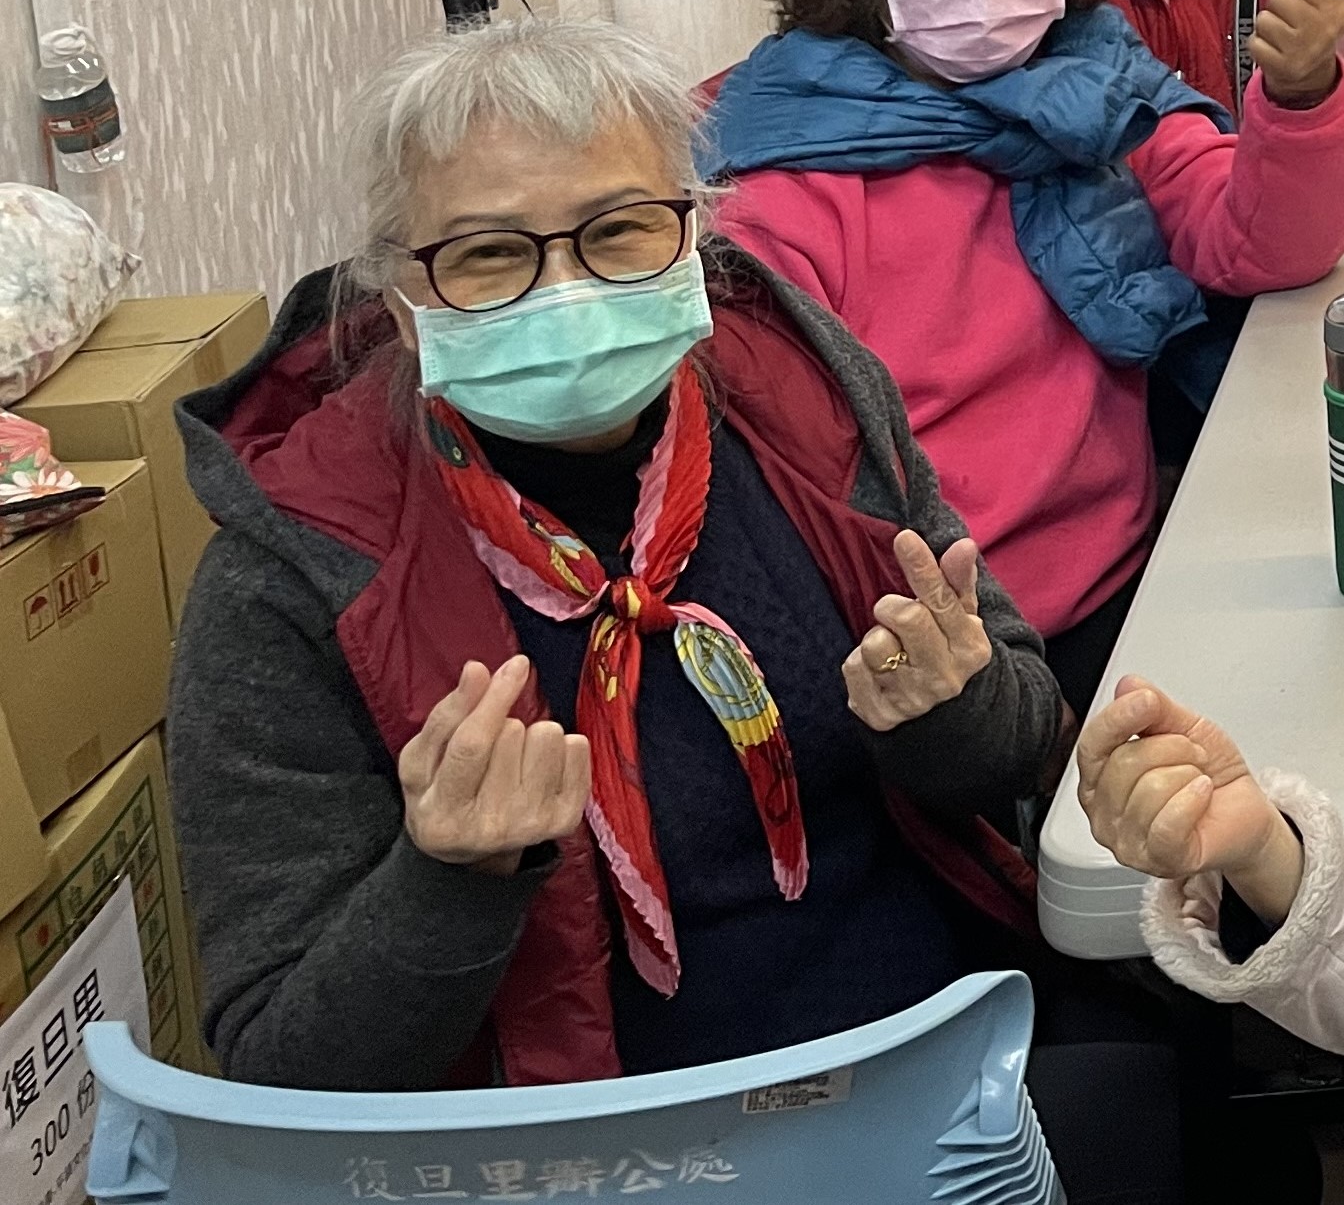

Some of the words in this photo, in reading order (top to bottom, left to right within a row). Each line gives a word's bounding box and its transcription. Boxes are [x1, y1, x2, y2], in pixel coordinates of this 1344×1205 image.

[1, 968, 106, 1131] 復旦里
[31, 1102, 70, 1177] 300
[344, 1141, 741, 1202] 復旦里辦公處
